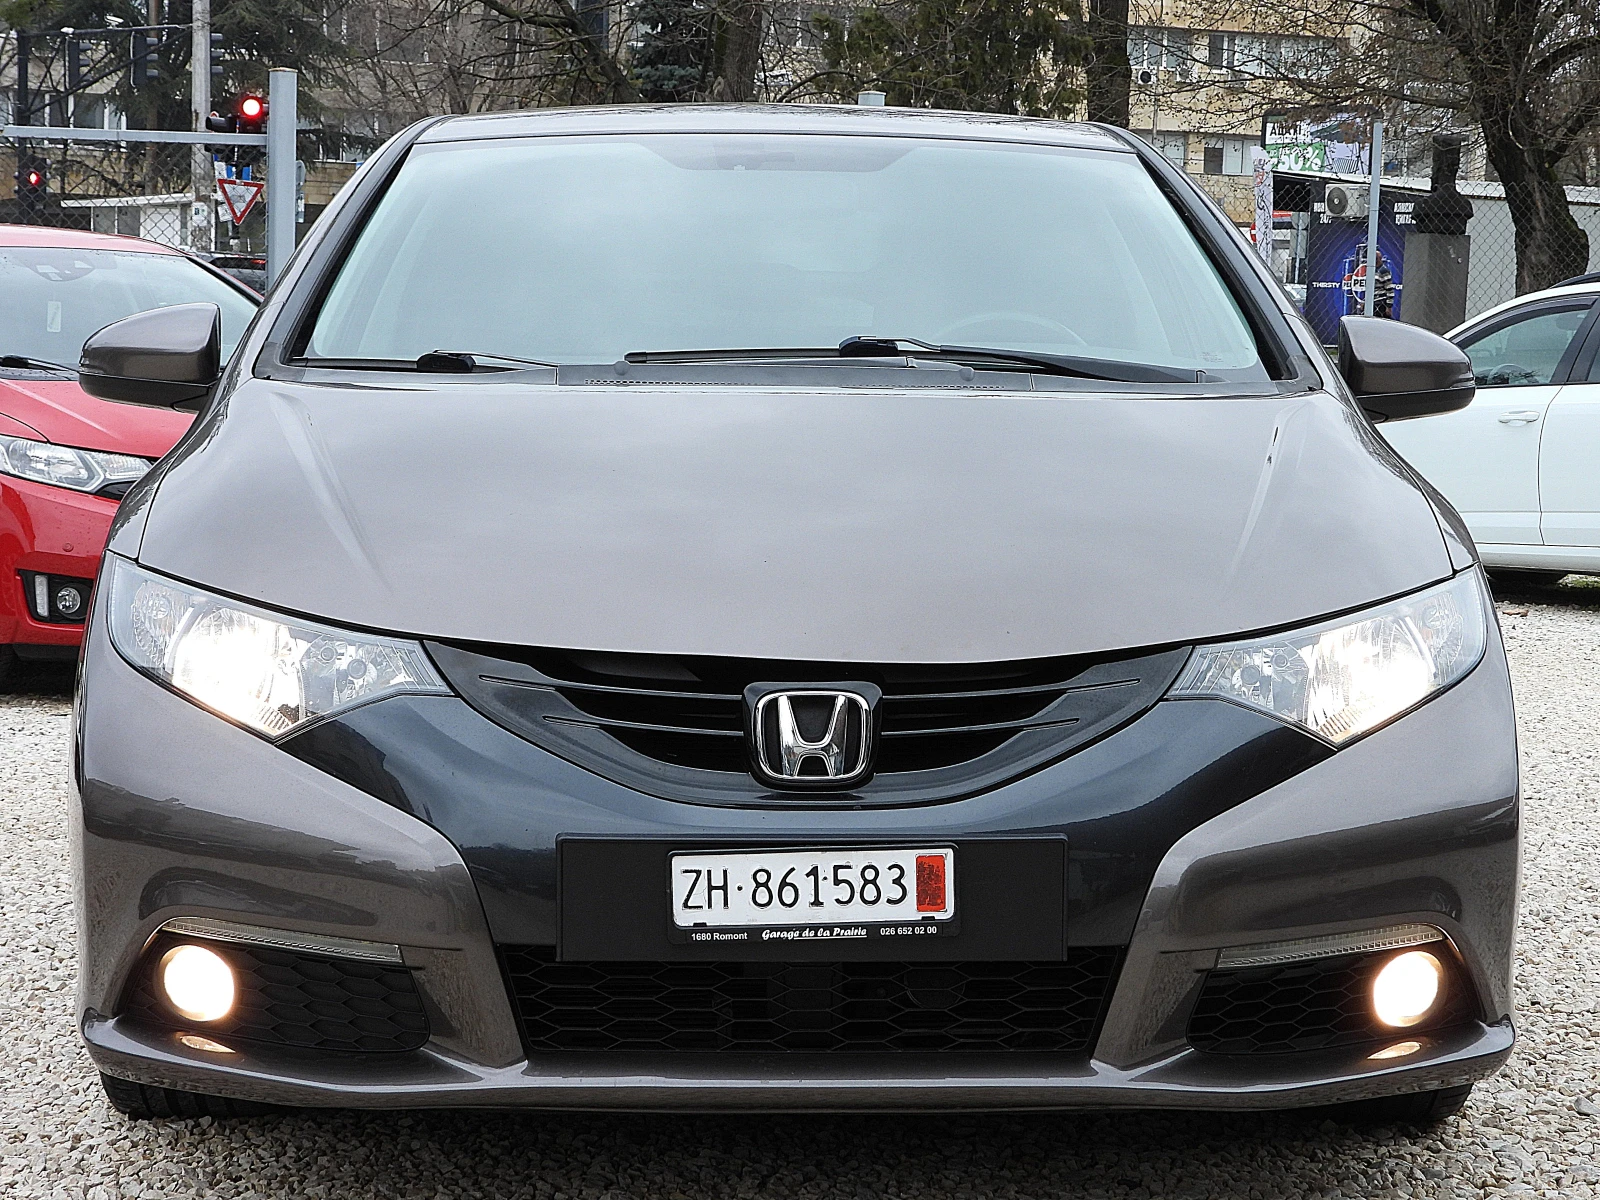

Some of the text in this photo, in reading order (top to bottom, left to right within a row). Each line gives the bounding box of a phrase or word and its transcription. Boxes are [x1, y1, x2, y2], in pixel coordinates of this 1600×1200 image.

[761, 926, 867, 940] Garage de la Prairie
[880, 926, 937, 936] 026 652 02 00
[691, 932, 748, 941] 1680 Romont
